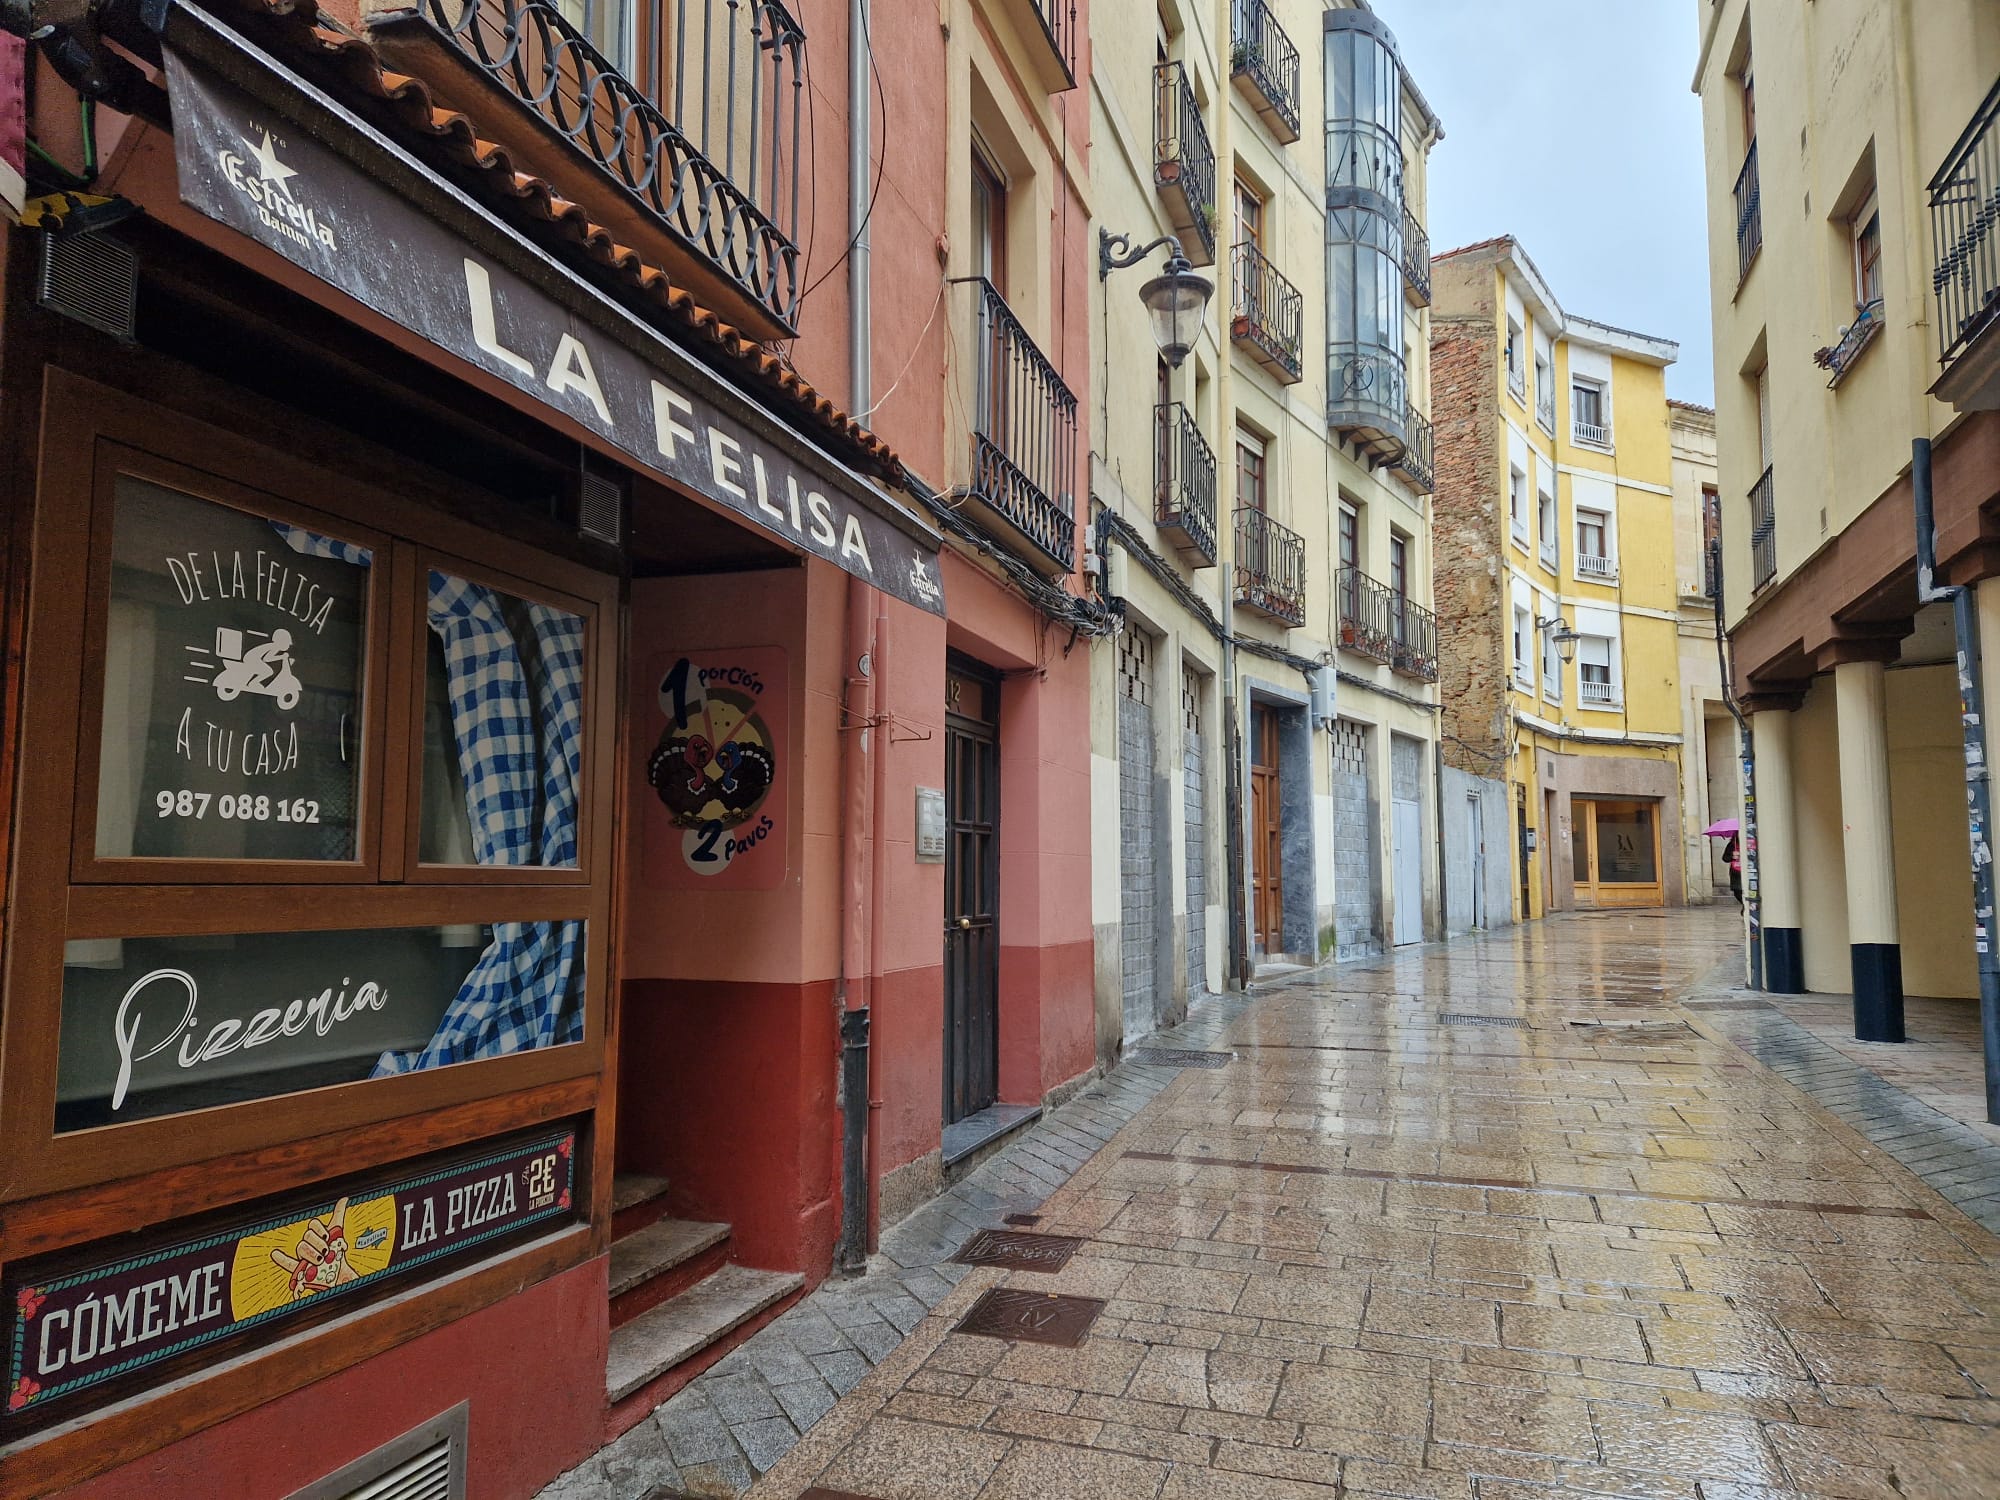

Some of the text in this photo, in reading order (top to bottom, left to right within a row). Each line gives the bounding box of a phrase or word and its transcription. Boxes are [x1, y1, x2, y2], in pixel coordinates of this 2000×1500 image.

[219, 150, 338, 252] Estrella
[256, 204, 311, 250] Damm
[463, 257, 873, 573] LA FELISA
[166, 550, 335, 635] DE LA FELISA
[176, 706, 299, 776] A TU CASA
[156, 789, 320, 824] 987 088 162
[690, 819, 724, 862] 2
[111, 968, 388, 1111] Pizzeria
[37, 1171, 518, 1376] CÓMEME LA PIZZA
